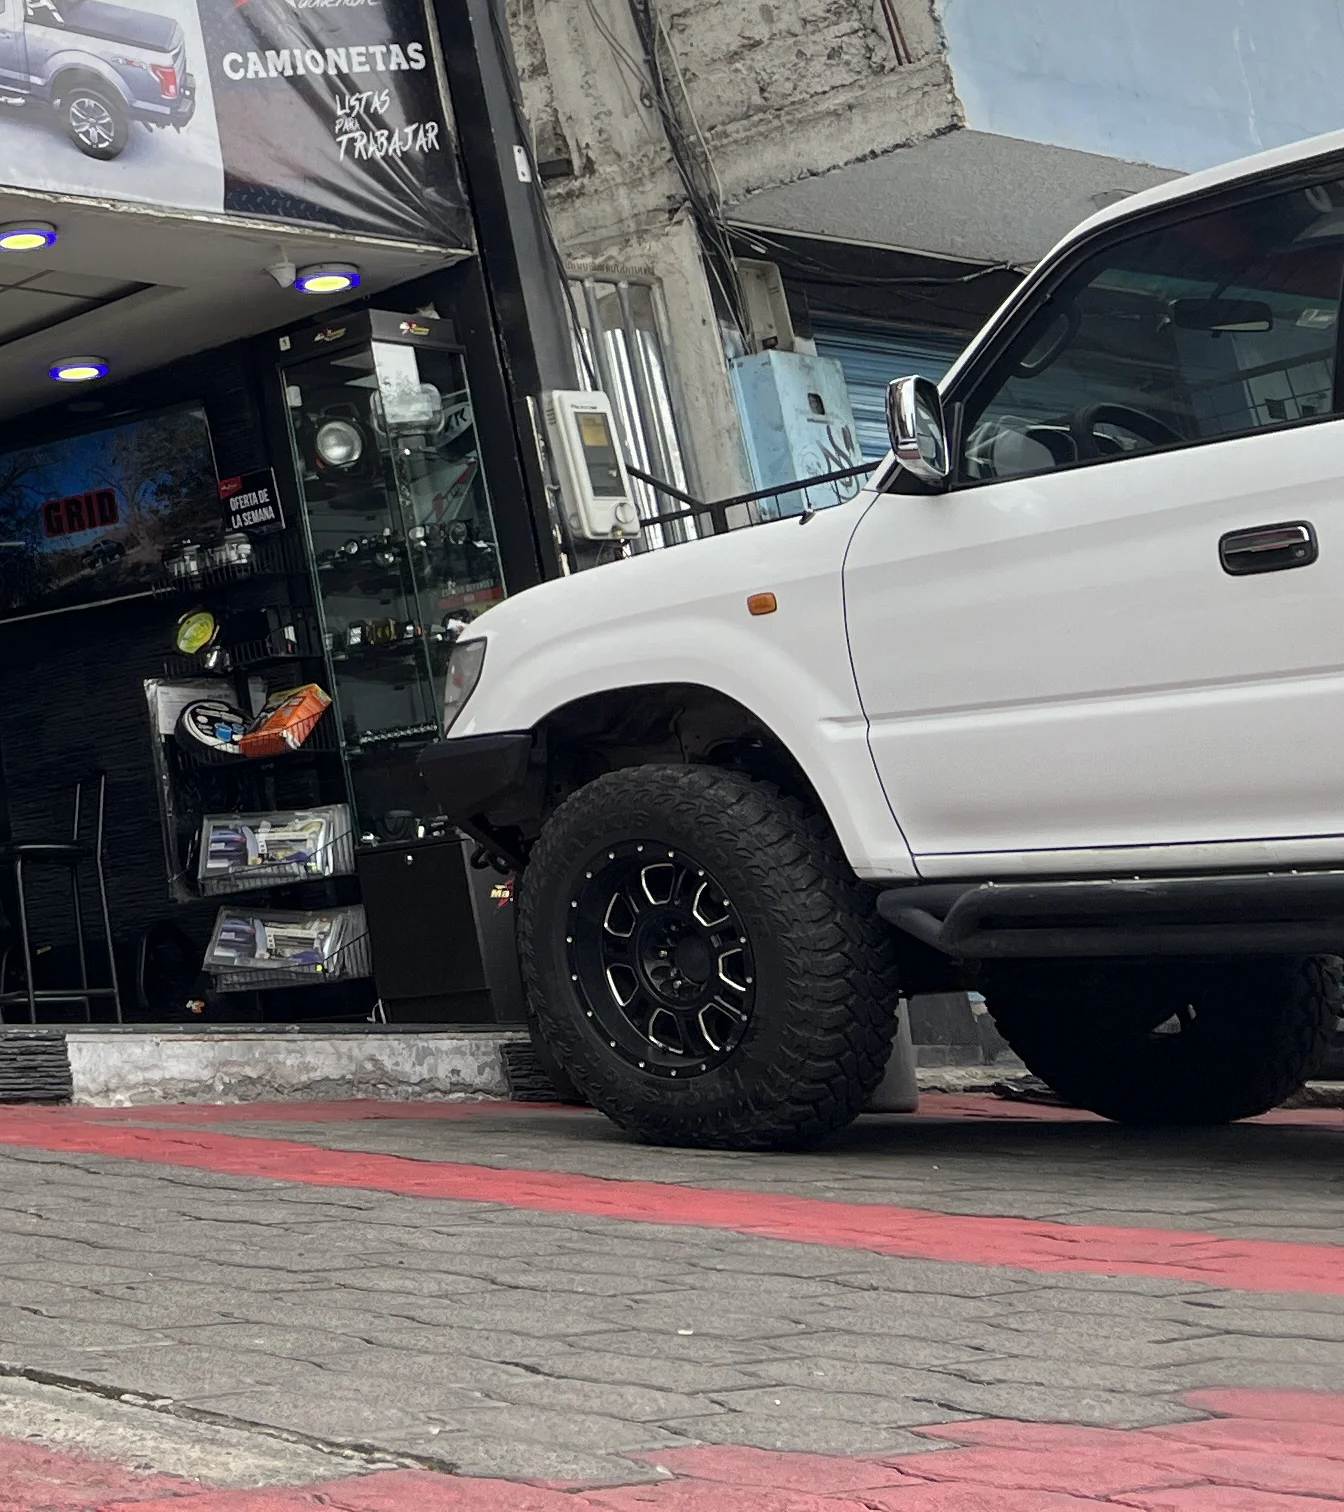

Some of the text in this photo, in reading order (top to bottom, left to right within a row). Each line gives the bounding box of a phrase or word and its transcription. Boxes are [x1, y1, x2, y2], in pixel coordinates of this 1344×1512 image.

[223, 42, 426, 80] CAMIONETAS
[335, 89, 390, 117] LISTAS
[335, 116, 361, 134] PARA
[336, 121, 439, 162] TRABAJAR
[45, 491, 117, 536] GRID
[229, 488, 270, 511] OFERTA DE
[231, 506, 275, 529] LA SEMANA
